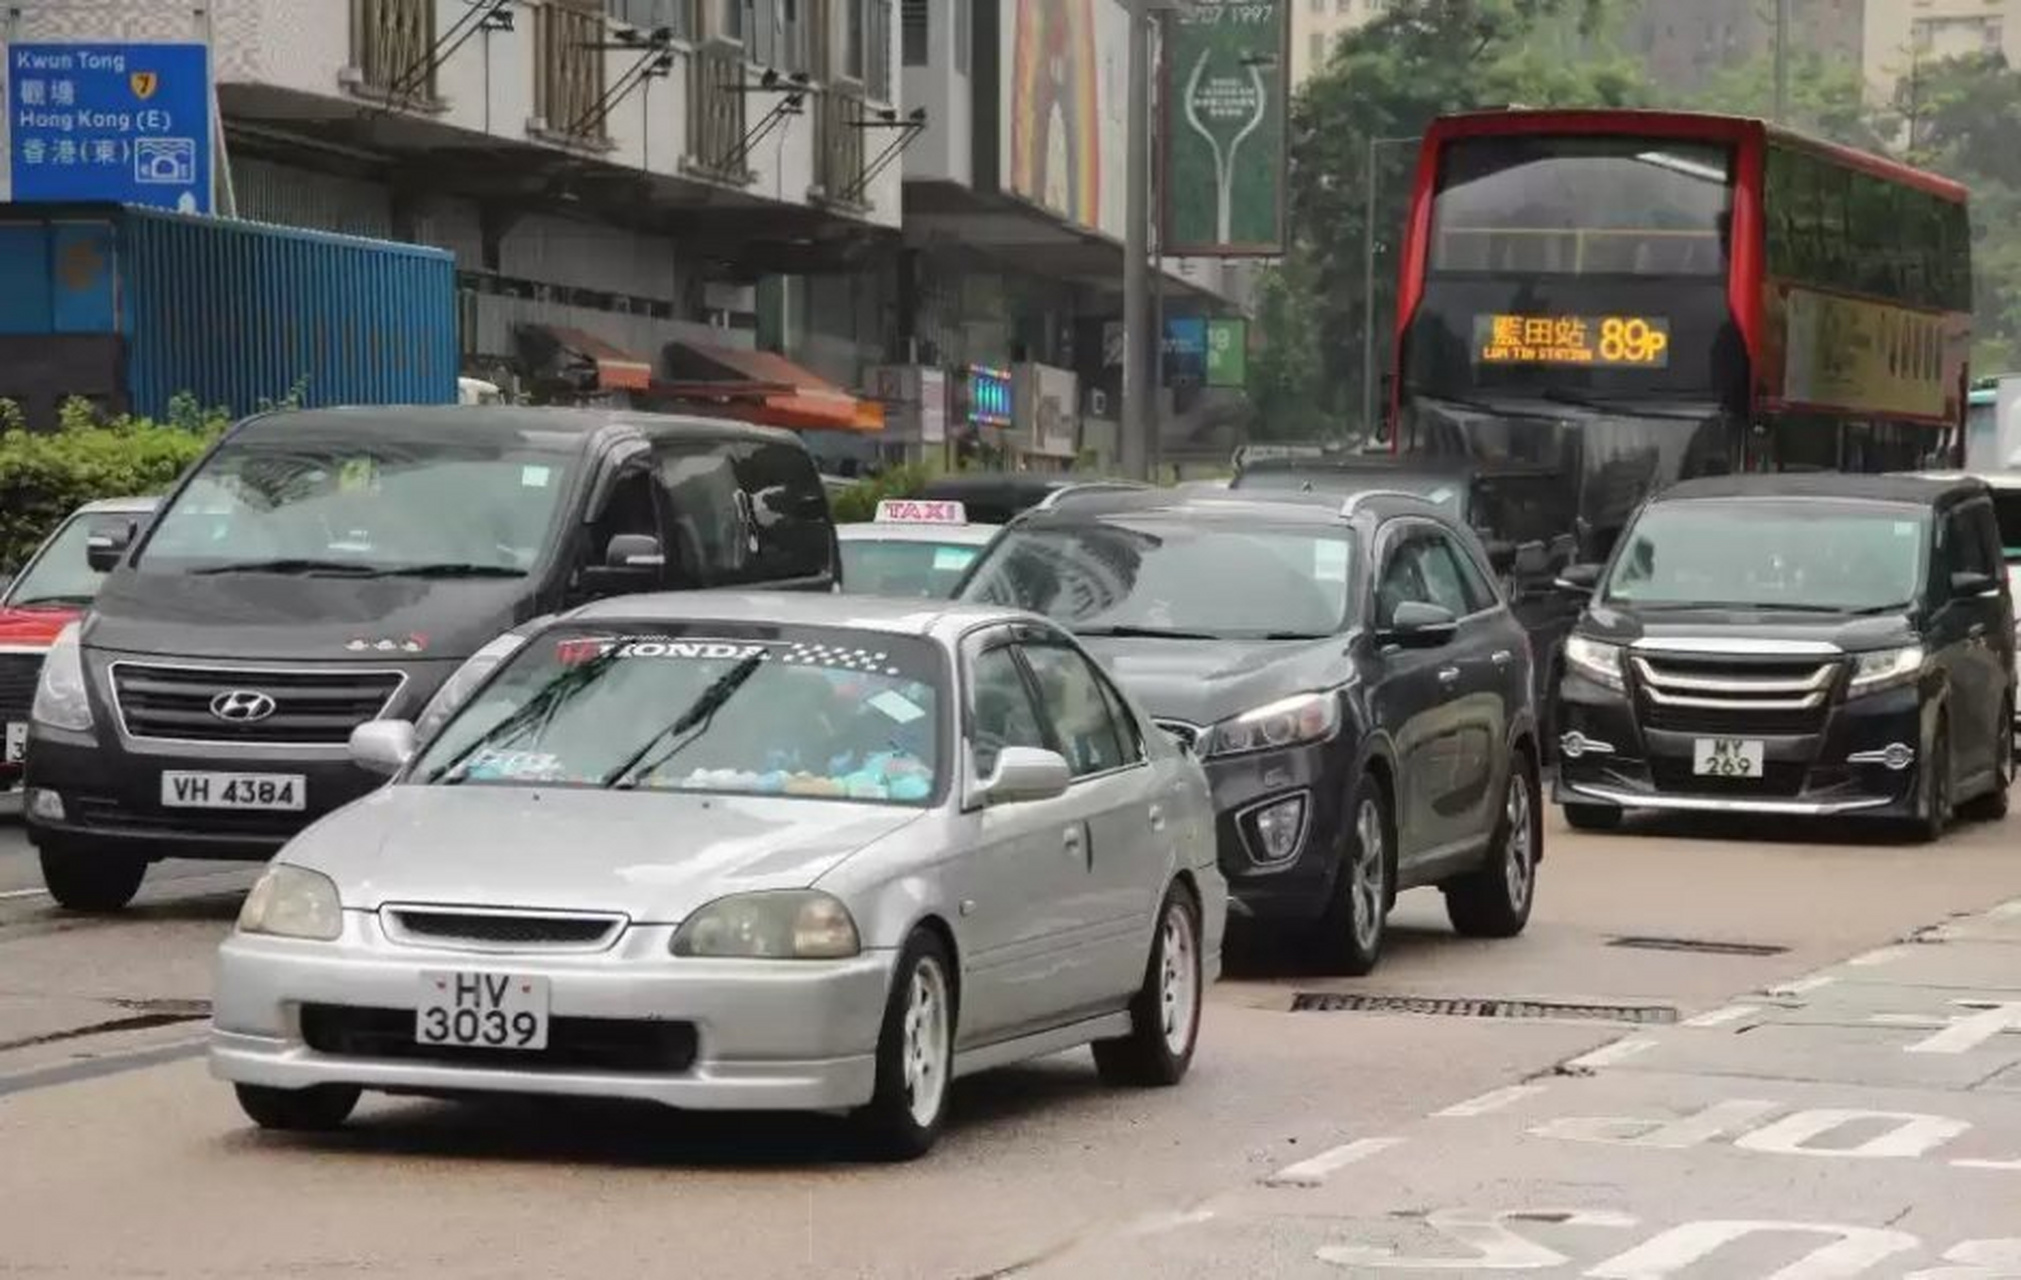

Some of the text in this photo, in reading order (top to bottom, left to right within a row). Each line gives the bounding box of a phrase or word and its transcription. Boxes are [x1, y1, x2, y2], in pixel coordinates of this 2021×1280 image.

[17, 52, 125, 72] Kwun Tong
[20, 79, 75, 106] 觀塘
[137, 75, 151, 93] 7
[20, 110, 171, 131] Hong Kong (E)
[1600, 318, 1667, 361] 89P
[884, 502, 956, 519] TAXI
[1715, 740, 1743, 758] MY
[1706, 757, 1751, 775] 269
[173, 777, 294, 804] VH 4384
[456, 972, 510, 1008] HV
[425, 1006, 538, 1046] 3039
